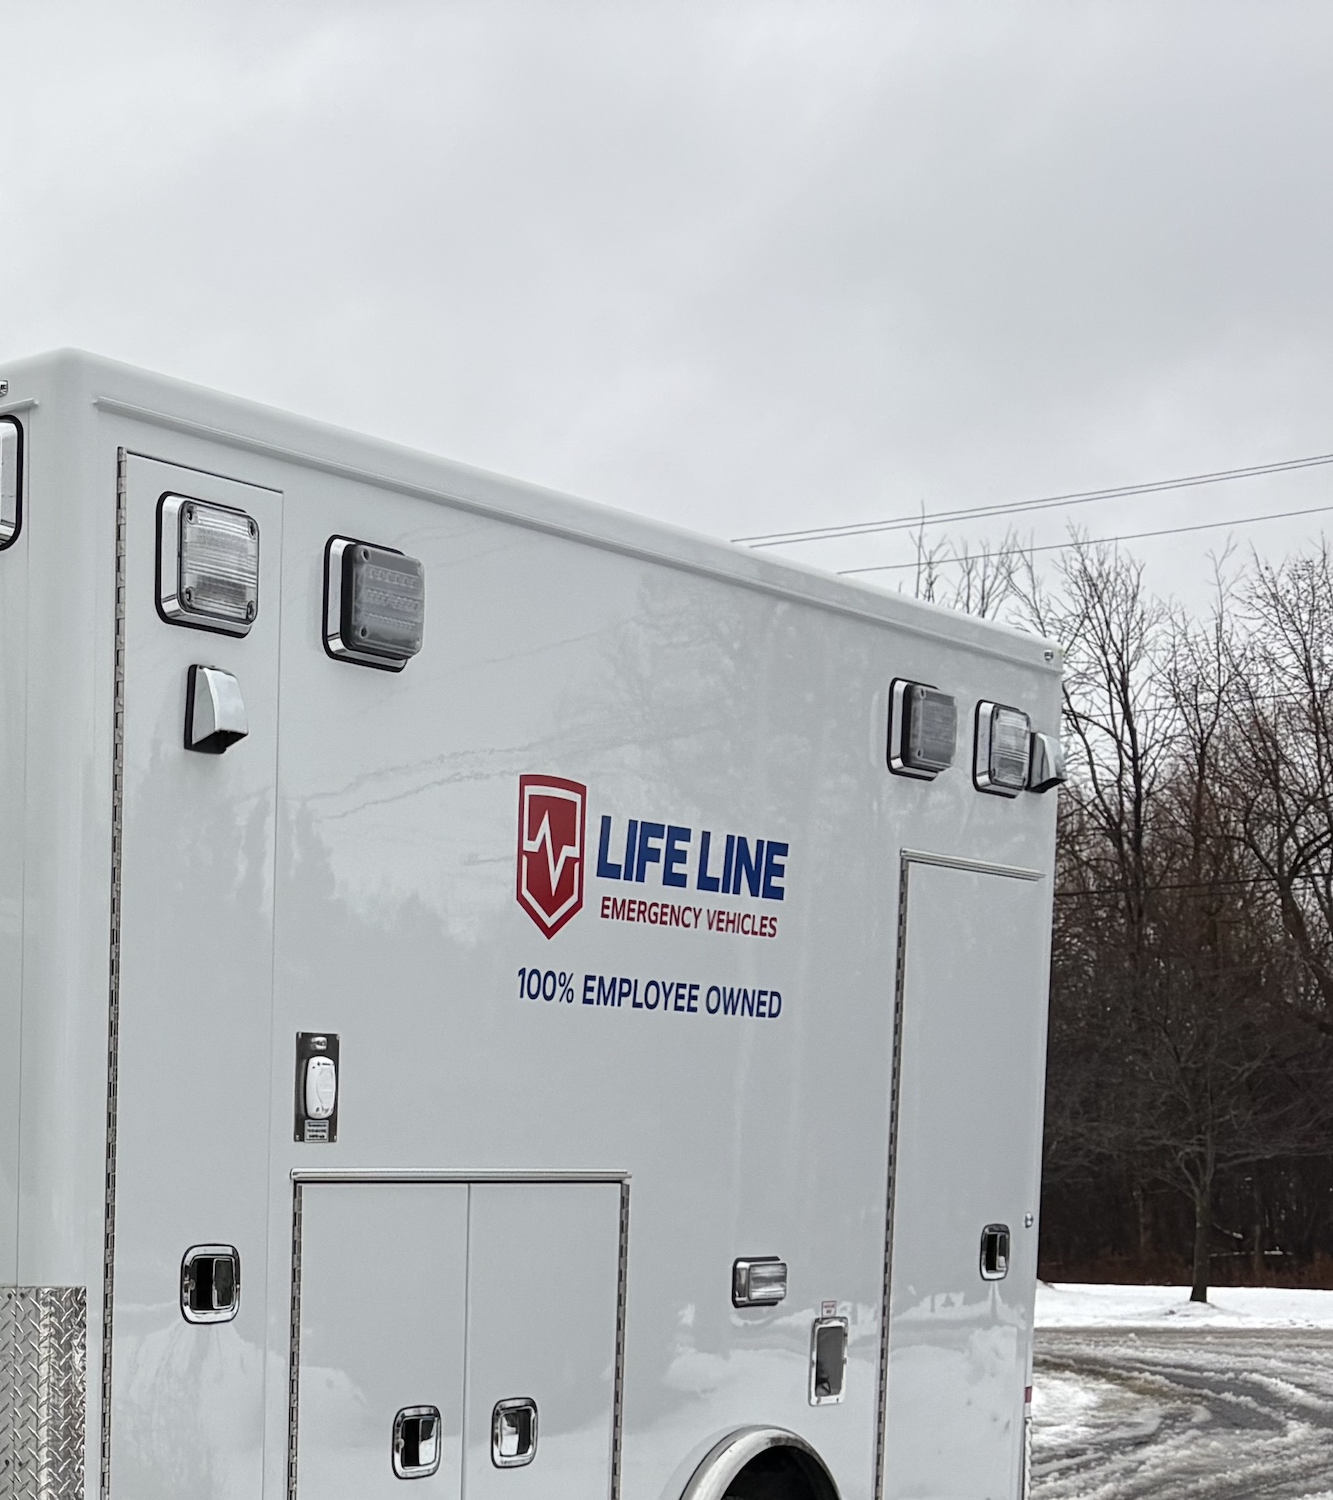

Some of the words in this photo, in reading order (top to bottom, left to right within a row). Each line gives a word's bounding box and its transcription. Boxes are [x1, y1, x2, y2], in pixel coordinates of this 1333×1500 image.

[596, 815, 692, 888] LIFE
[696, 830, 789, 900] LINE
[600, 896, 702, 930] EMERGENCY
[707, 909, 777, 938] VEHICLES
[518, 967, 574, 1003] 100%
[582, 975, 699, 1013] EMPLOYEE
[706, 985, 782, 1018] OWNED
